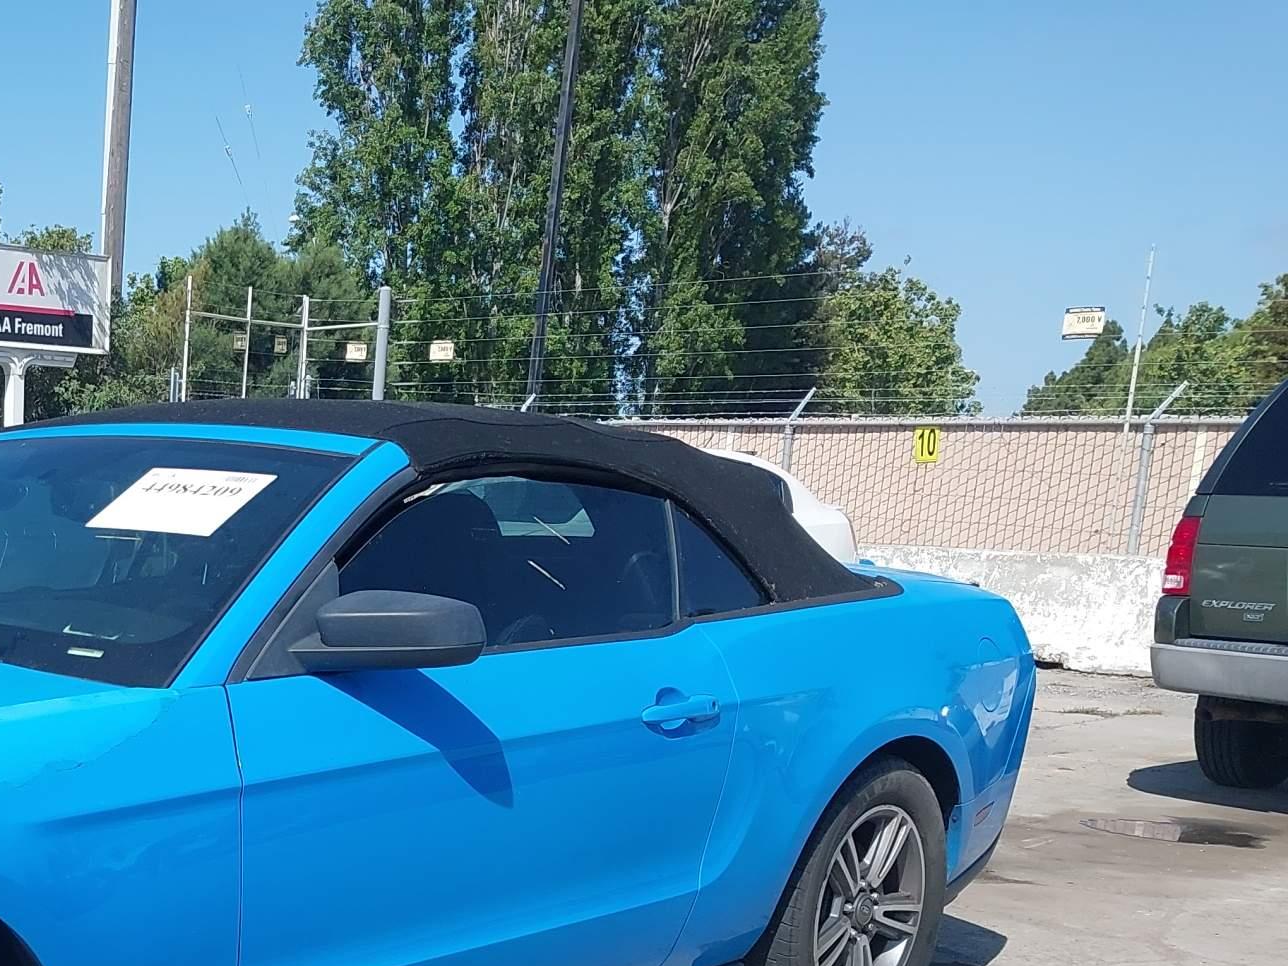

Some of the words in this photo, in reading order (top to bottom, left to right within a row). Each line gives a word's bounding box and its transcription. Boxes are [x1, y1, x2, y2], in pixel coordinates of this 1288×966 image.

[15, 318, 64, 337] Fremont
[918, 428, 936, 457] 10
[141, 481, 243, 498] 44984209
[1201, 599, 1277, 611] EXPLORER
